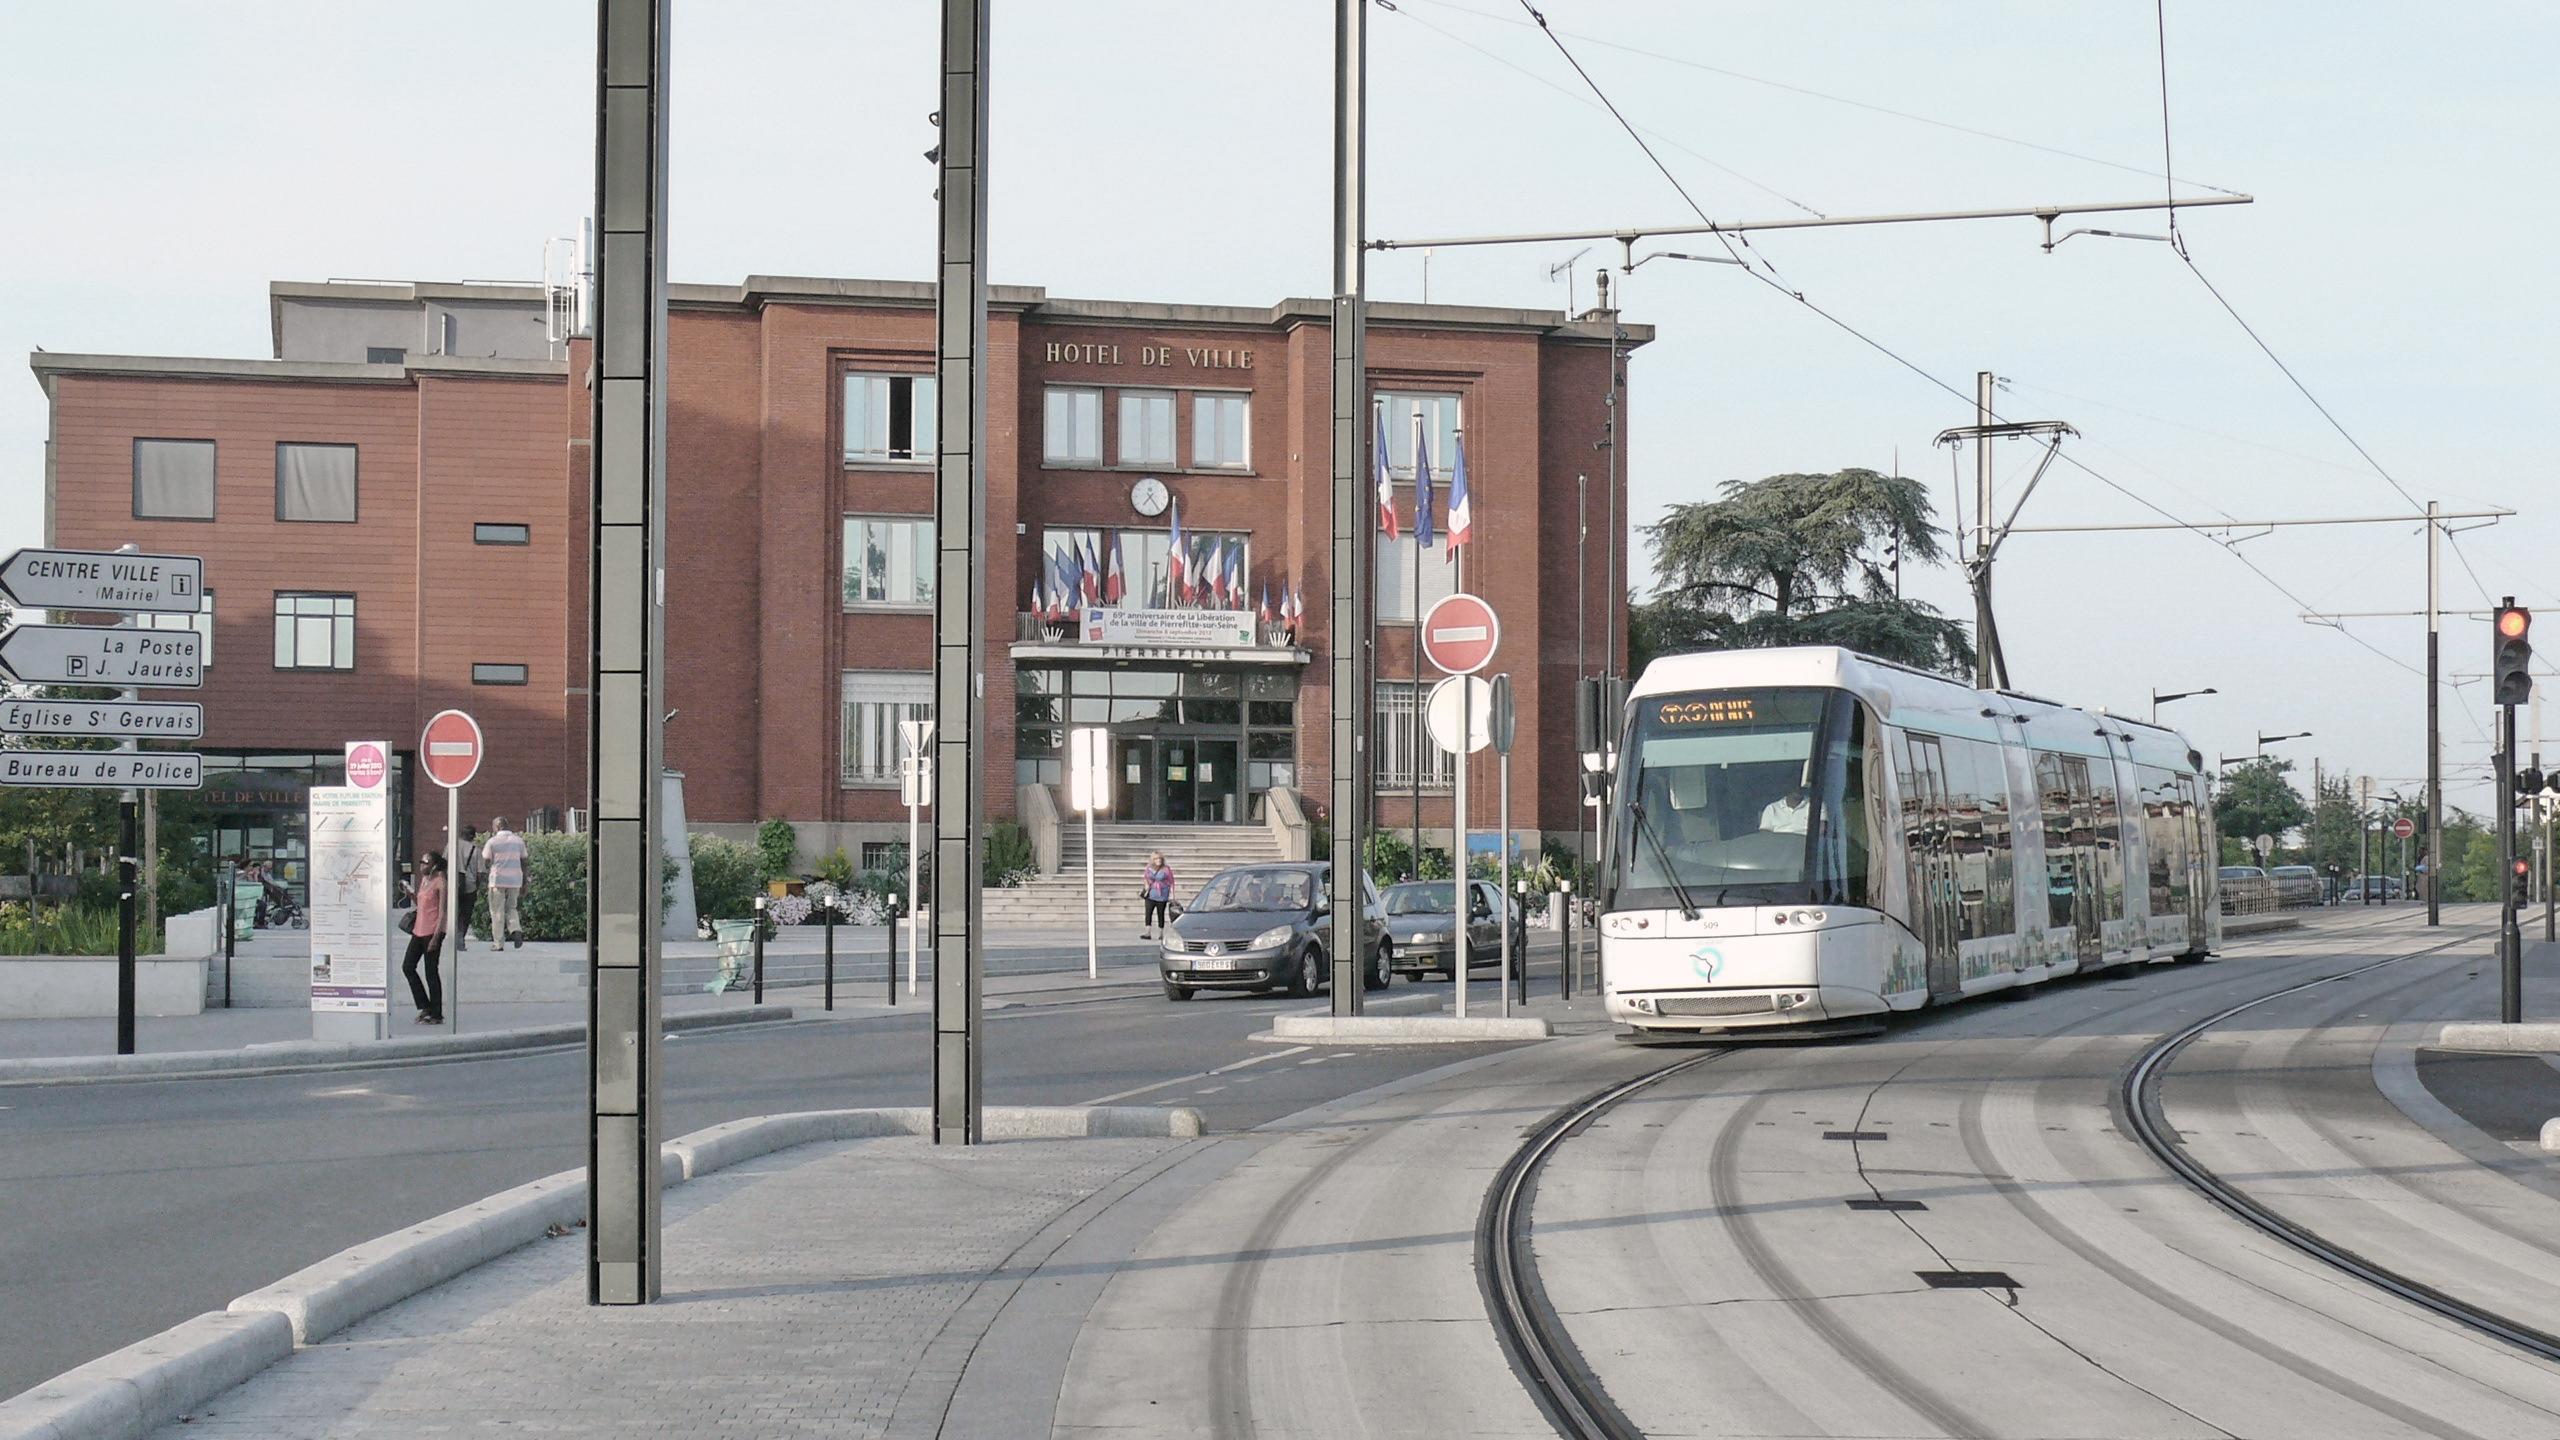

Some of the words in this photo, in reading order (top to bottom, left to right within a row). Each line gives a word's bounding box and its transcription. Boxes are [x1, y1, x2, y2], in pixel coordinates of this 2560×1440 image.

[1046, 342, 1124, 365] HOTEL
[1142, 346, 1171, 367] DE
[1186, 348, 1254, 369] VILLE
[27, 561, 100, 579] CENTRE
[112, 565, 160, 582] VILLE
[96, 586, 160, 601] (Mairie)
[1127, 612, 1174, 621] anniversaire
[1177, 612, 1185, 621] de
[1187, 613, 1195, 621] la
[1197, 613, 1235, 623] Libération
[1130, 620, 1146, 628] ville
[1160, 621, 1238, 630] Pierrefitte-sur-Seine
[103, 638, 124, 654] La
[139, 639, 194, 655] Poste
[1102, 648, 1232, 659] PIERREFITTE
[71, 658, 83, 674] P
[95, 660, 111, 676] J.
[128, 660, 194, 678] Jaurès
[9, 705, 72, 729] Église
[88, 711, 106, 727] St
[120, 711, 193, 728] Gervais
[8, 760, 79, 777] Bureau
[95, 762, 116, 777] de
[132, 762, 193, 779] Police
